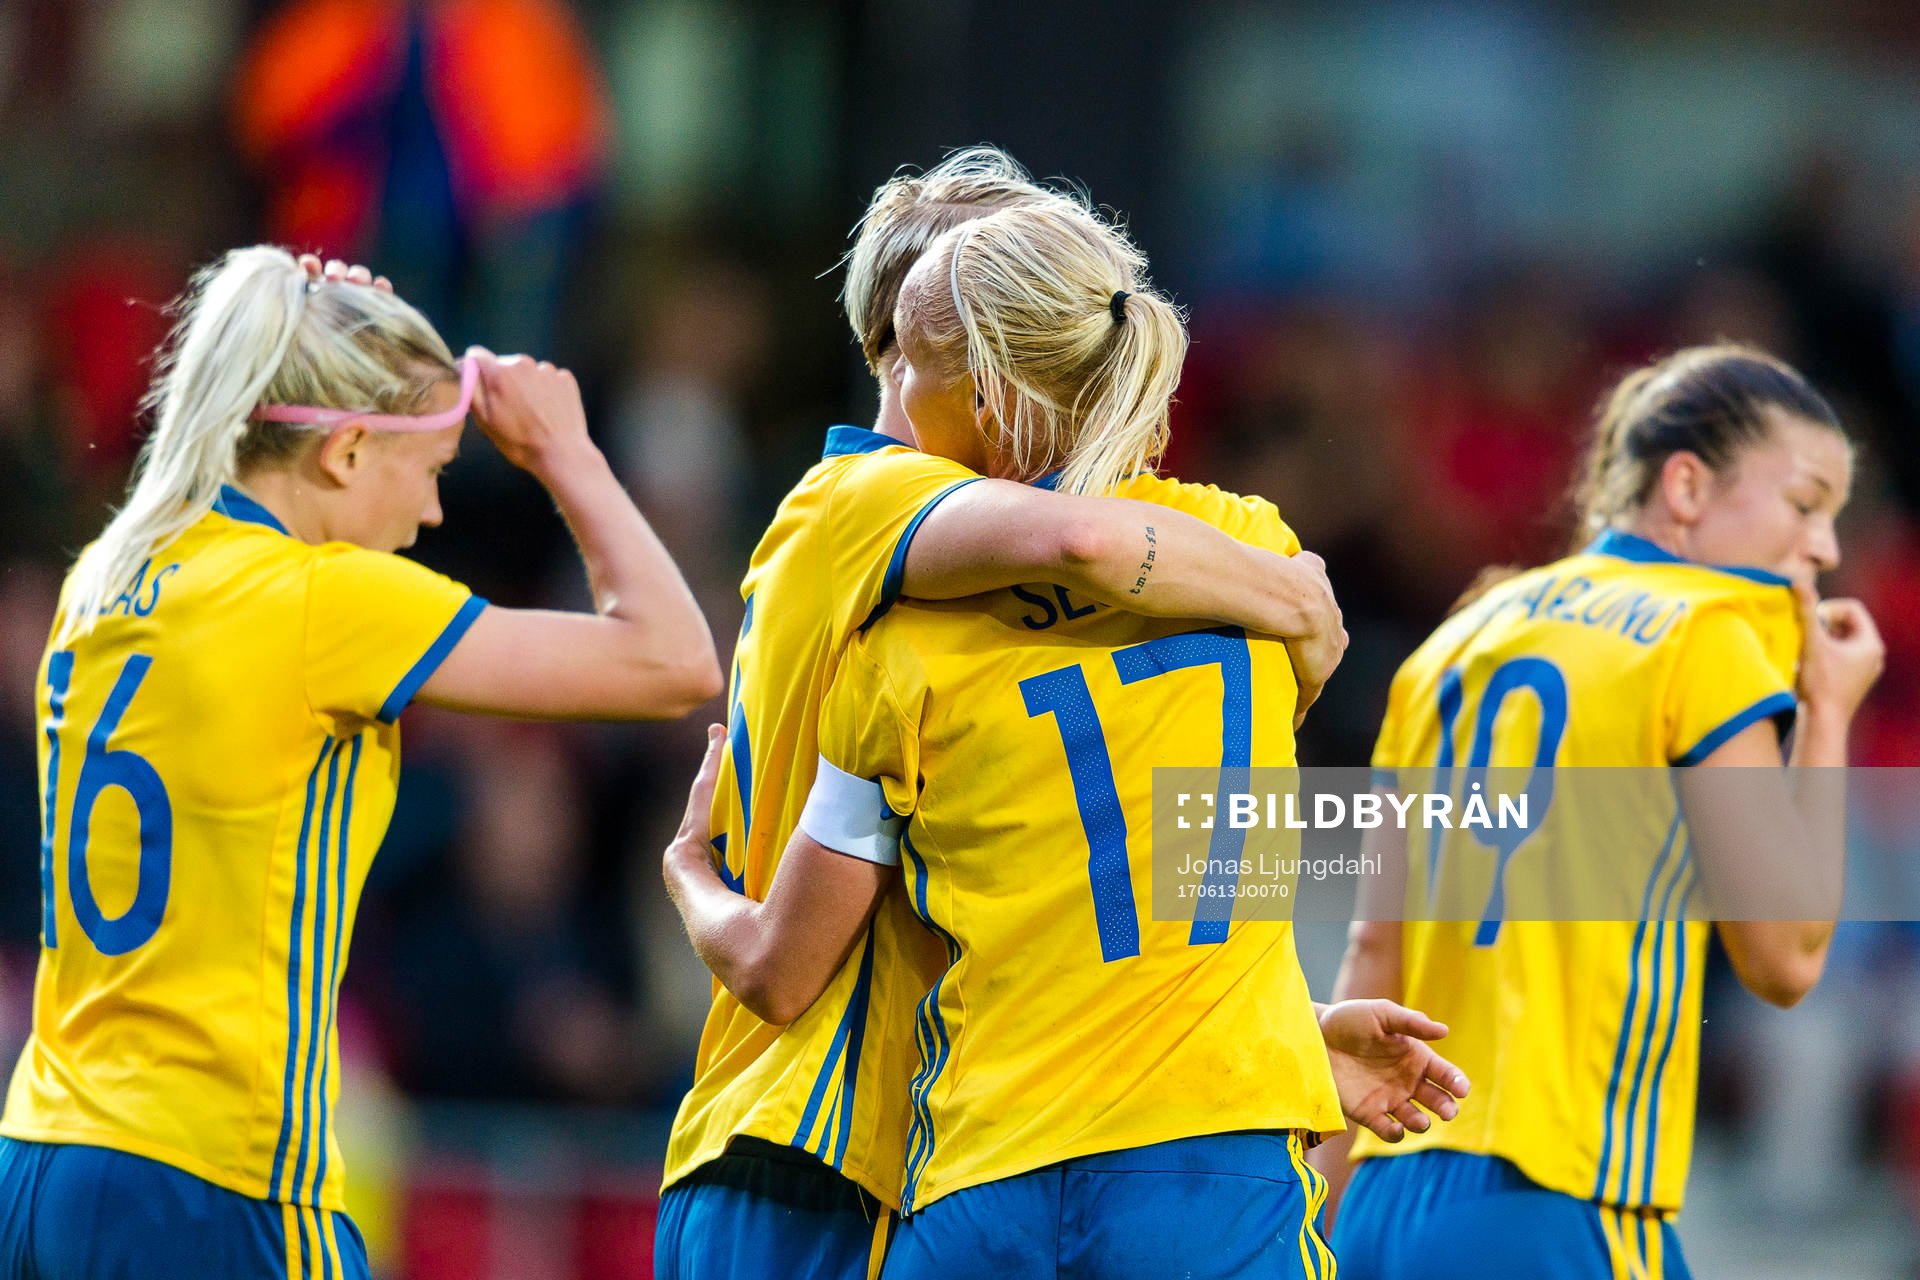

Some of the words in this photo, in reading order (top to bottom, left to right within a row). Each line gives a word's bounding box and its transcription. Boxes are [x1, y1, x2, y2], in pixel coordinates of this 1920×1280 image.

[80, 557, 181, 617] AS
[41, 650, 173, 956] 16
[1018, 625, 1252, 963] 17
[1427, 656, 1569, 947] 19
